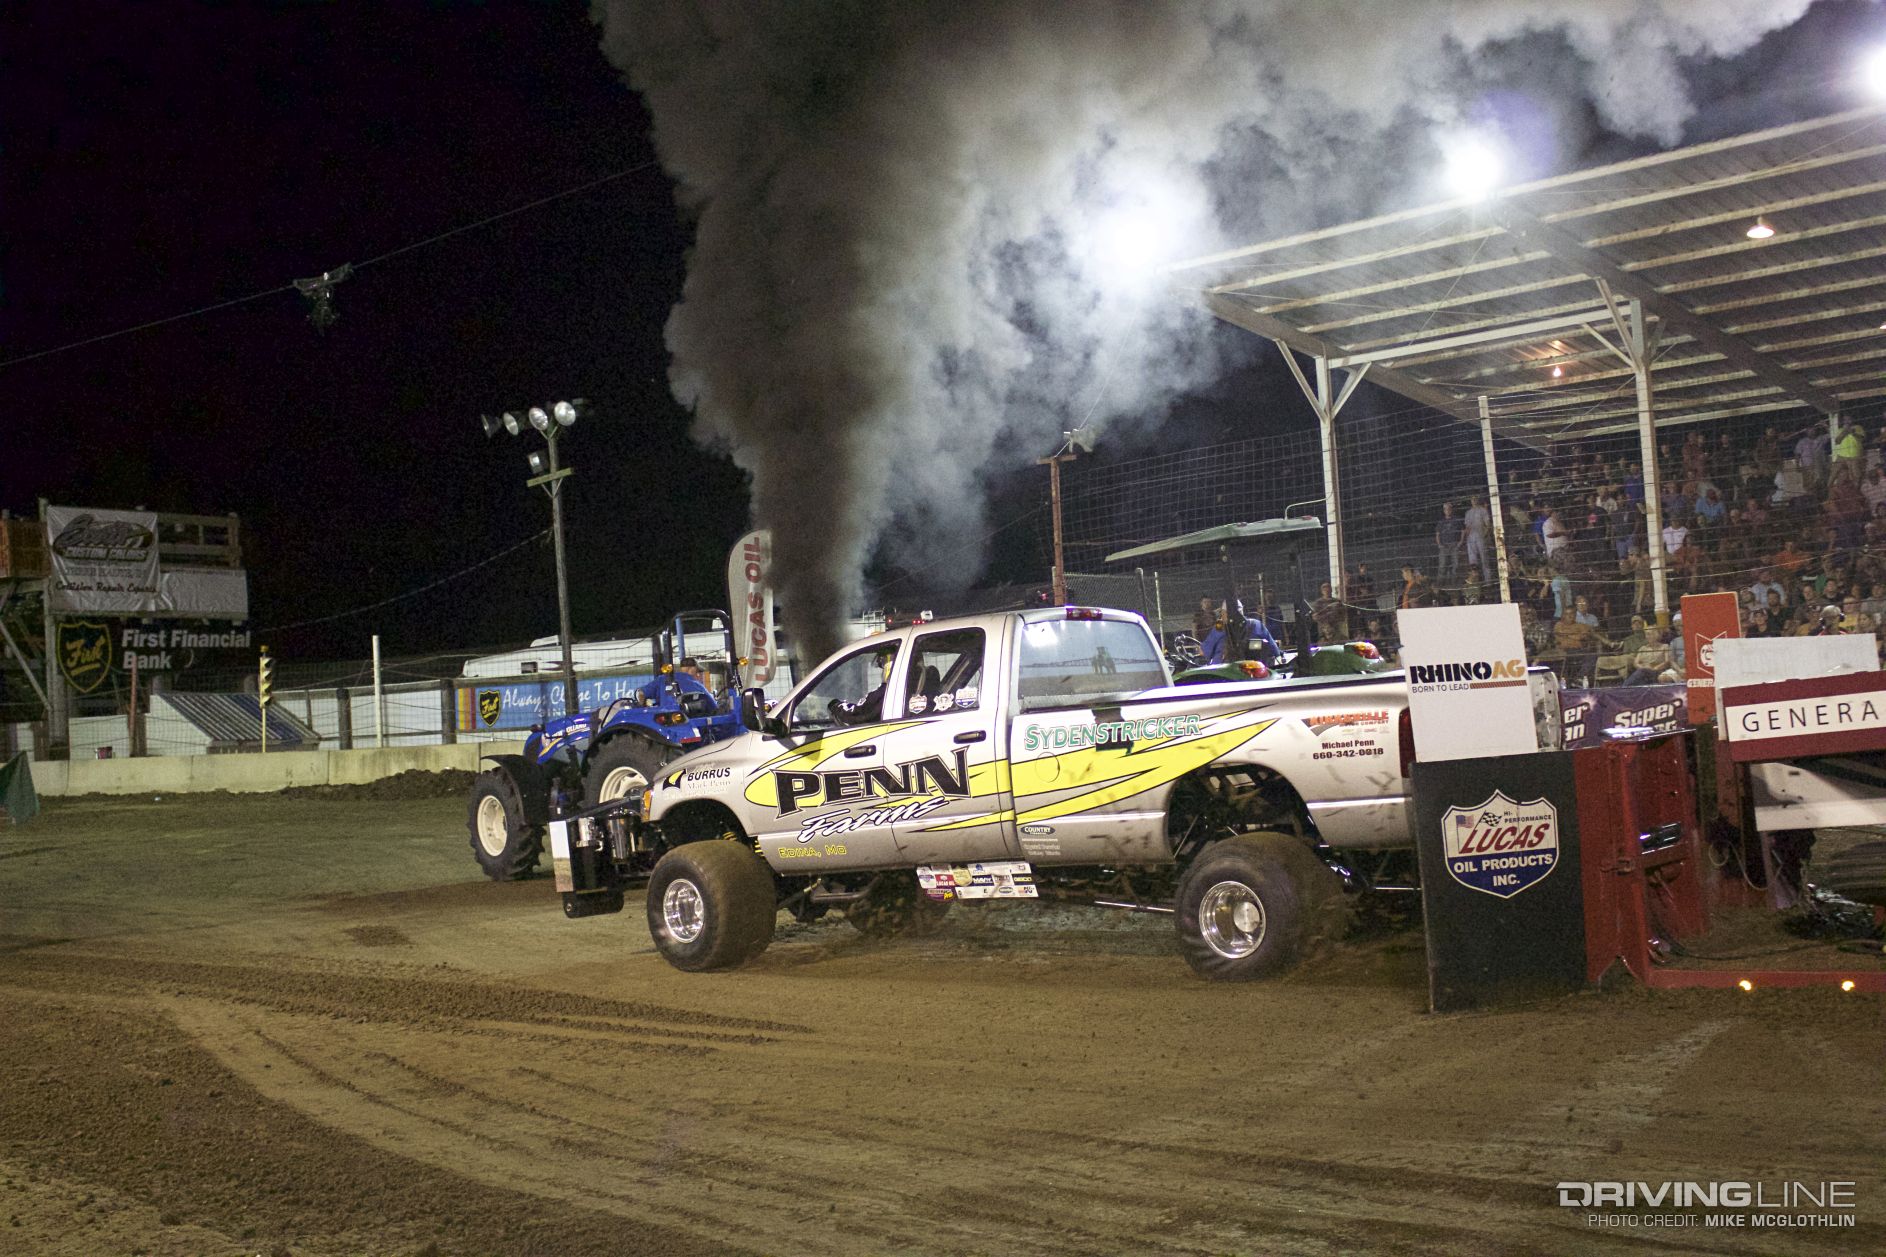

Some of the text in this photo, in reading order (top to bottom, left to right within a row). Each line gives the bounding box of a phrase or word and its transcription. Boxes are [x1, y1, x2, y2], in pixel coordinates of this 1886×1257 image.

[743, 536, 769, 682] LUCAS OIL
[121, 629, 251, 648] First Financial
[123, 651, 172, 669] Bank
[550, 685, 591, 706] Clse
[594, 682, 611, 701] To
[1411, 683, 1469, 693] BORN TO LEAD
[1614, 700, 1681, 728] Super
[1741, 700, 1879, 732] GENERA
[1024, 714, 1202, 751] SYDENSTRICKER
[1321, 739, 1375, 750] Michael Penn
[687, 767, 731, 781] BURRUS
[770, 745, 972, 819] PENN
[797, 796, 950, 843] Farms
[1504, 814, 1552, 824] PERFORMANCE
[1458, 823, 1551, 855] LUCAS
[1453, 854, 1554, 873] OIL PRODUCTS
[1492, 874, 1520, 887] INC.
